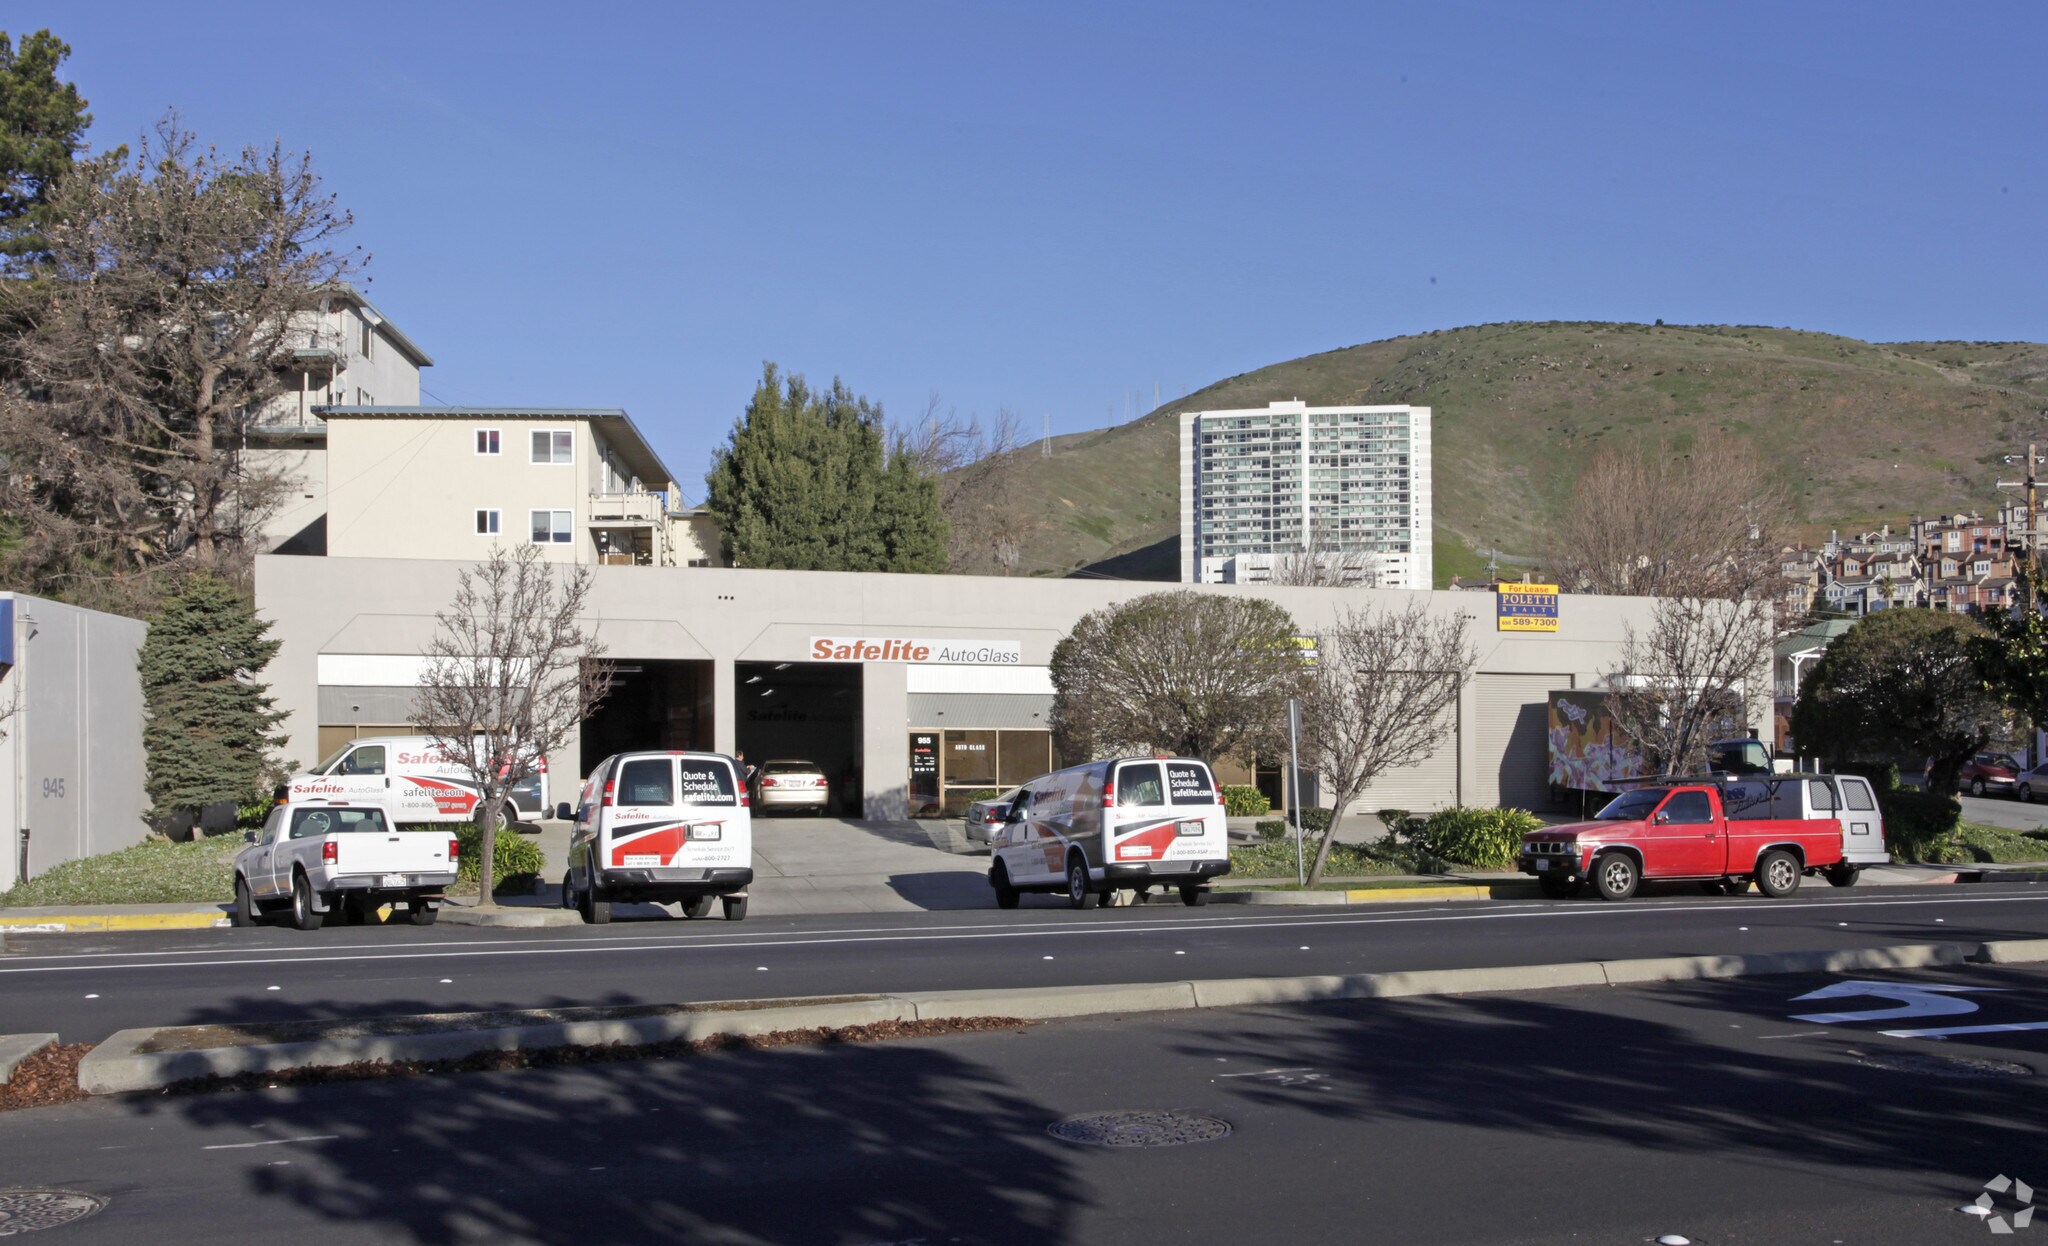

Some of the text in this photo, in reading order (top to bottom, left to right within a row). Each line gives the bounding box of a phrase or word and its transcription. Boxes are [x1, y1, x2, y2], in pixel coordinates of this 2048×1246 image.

[1502, 594, 1555, 604] POLETTI
[812, 639, 1019, 663] Safelite AutoGlass
[43, 777, 64, 798] 945
[293, 784, 344, 794] Safelite
[684, 782, 717, 790] Schedule
[403, 787, 465, 797] safelite.com
[684, 793, 733, 801] safelite.com
